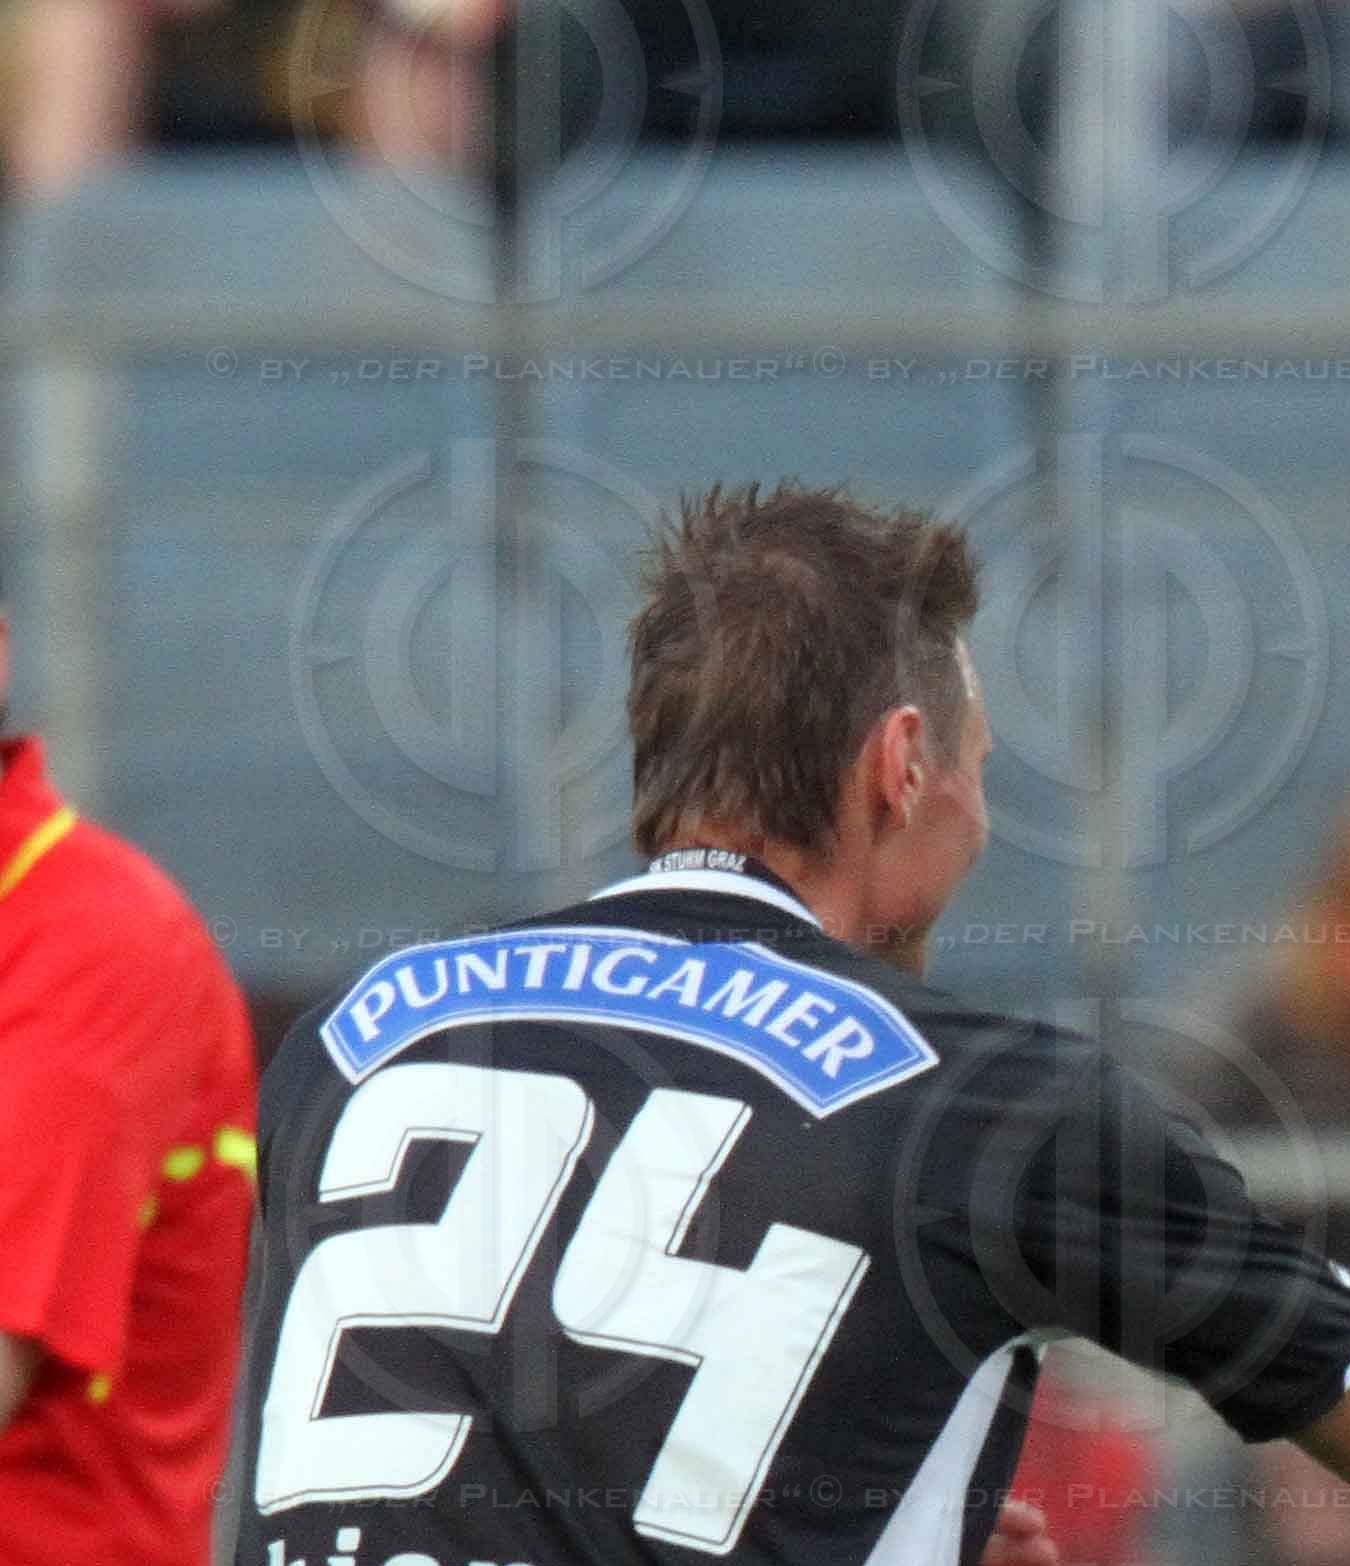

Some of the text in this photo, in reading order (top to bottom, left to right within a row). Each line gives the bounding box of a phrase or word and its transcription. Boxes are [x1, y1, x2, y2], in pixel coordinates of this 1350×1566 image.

[706, 849, 747, 873] GRAZ
[348, 942, 877, 1080] PUNTIGAMER
[255, 1061, 871, 1555] 24
